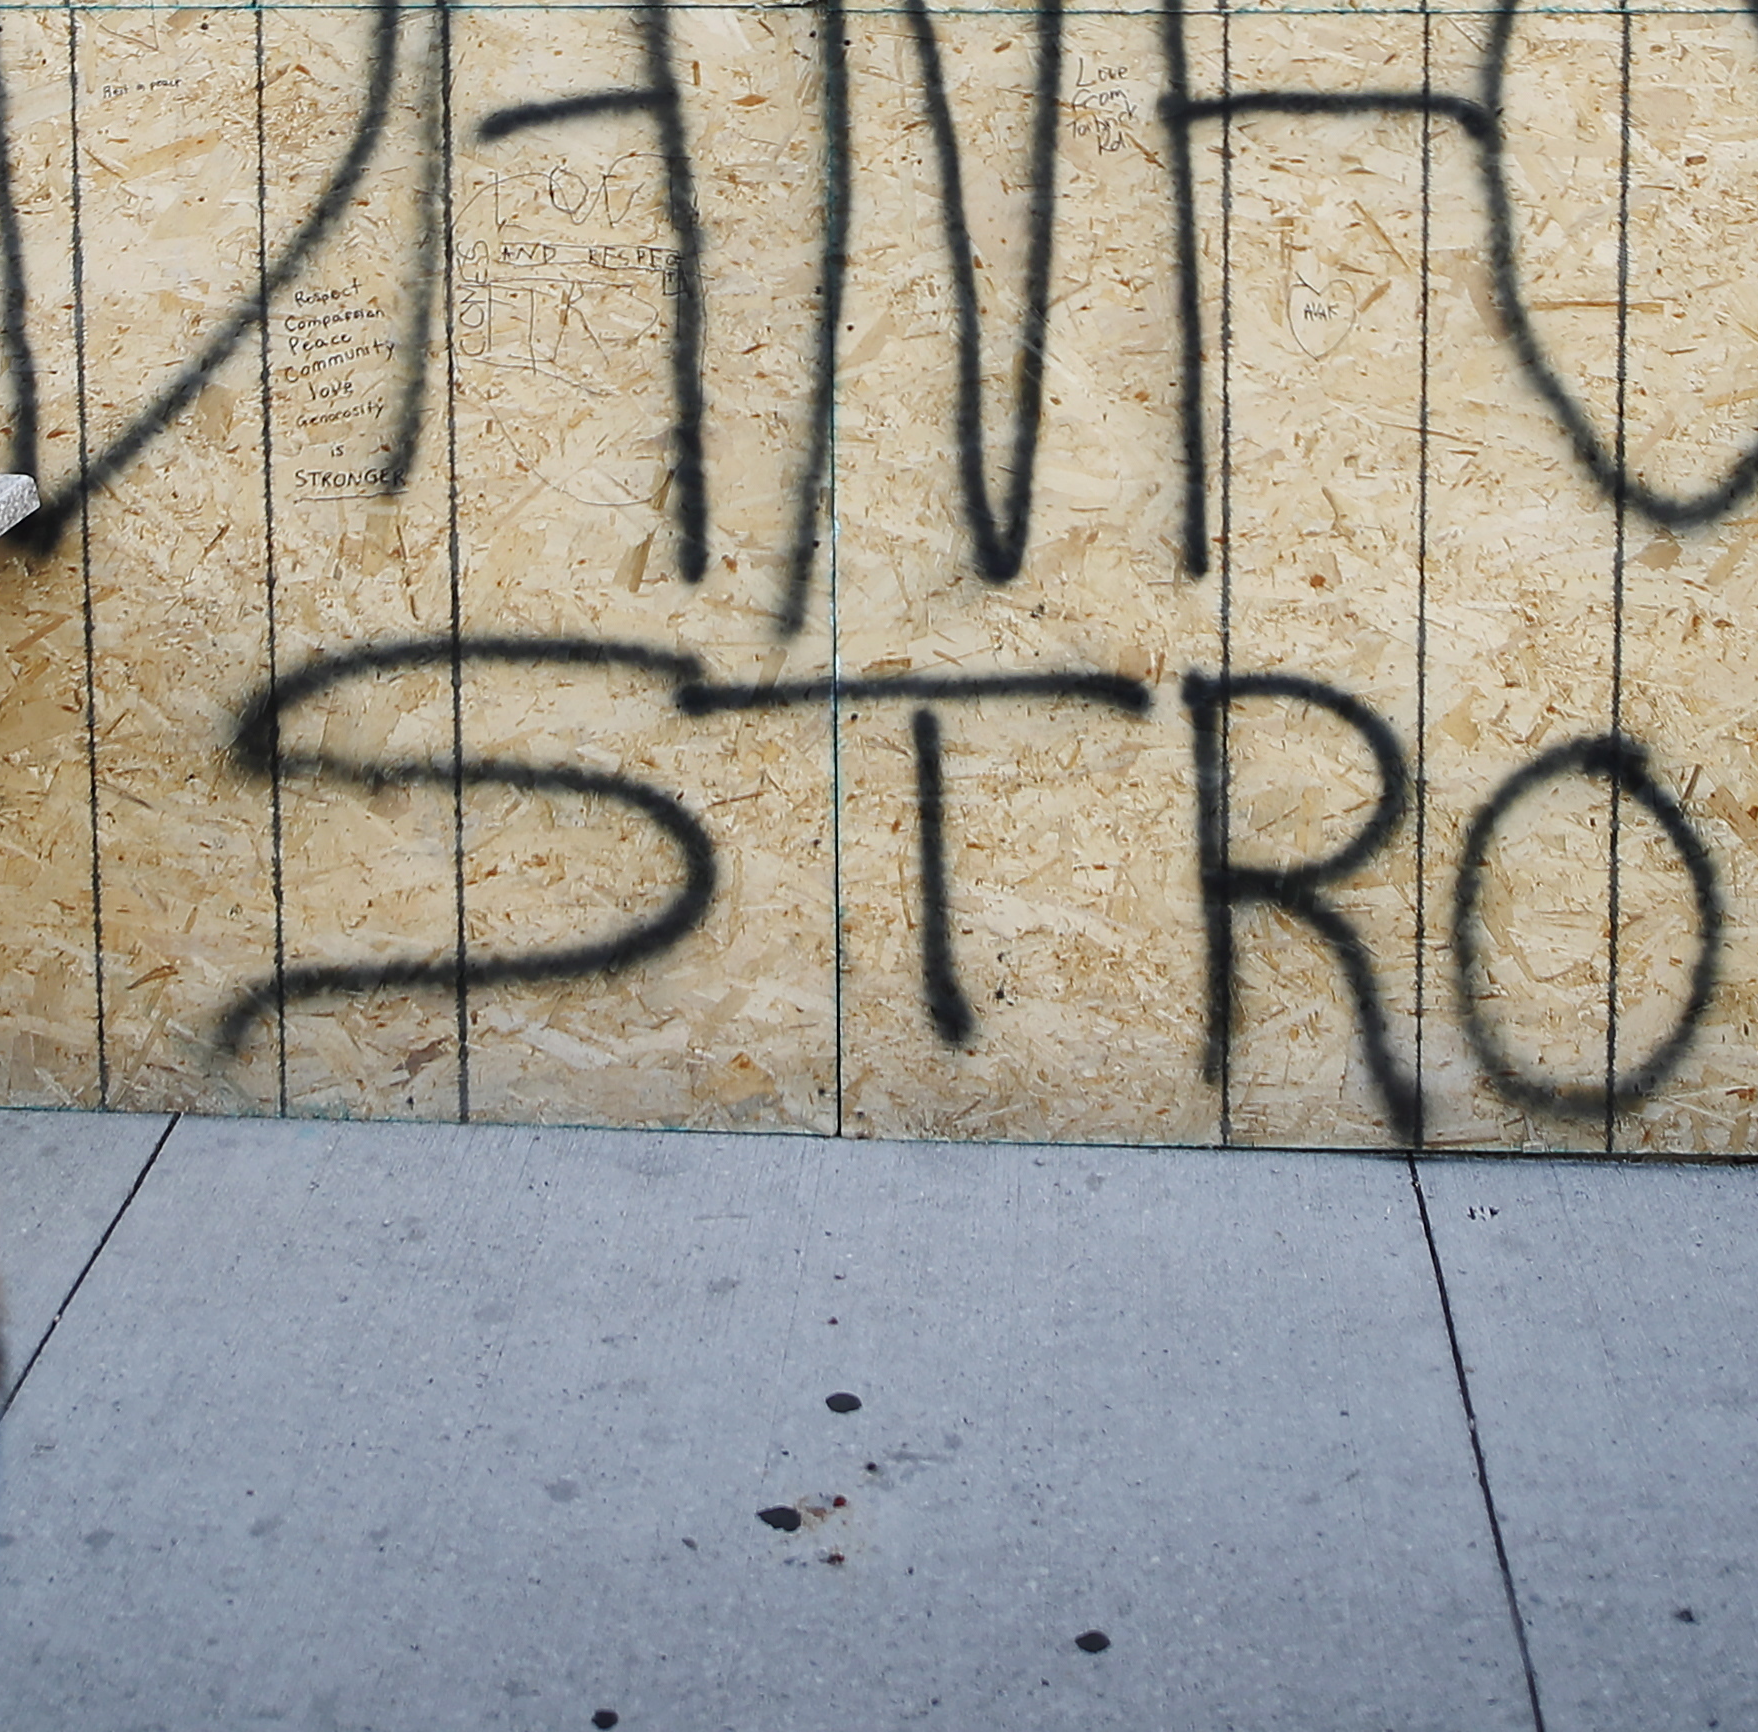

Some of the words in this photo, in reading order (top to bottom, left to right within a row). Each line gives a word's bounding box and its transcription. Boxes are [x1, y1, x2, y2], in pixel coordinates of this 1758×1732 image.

[1076, 58, 1128, 86] Love
[289, 334, 352, 356] Peace
[331, 444, 344, 457] is
[295, 469, 406, 488] STRONGER
